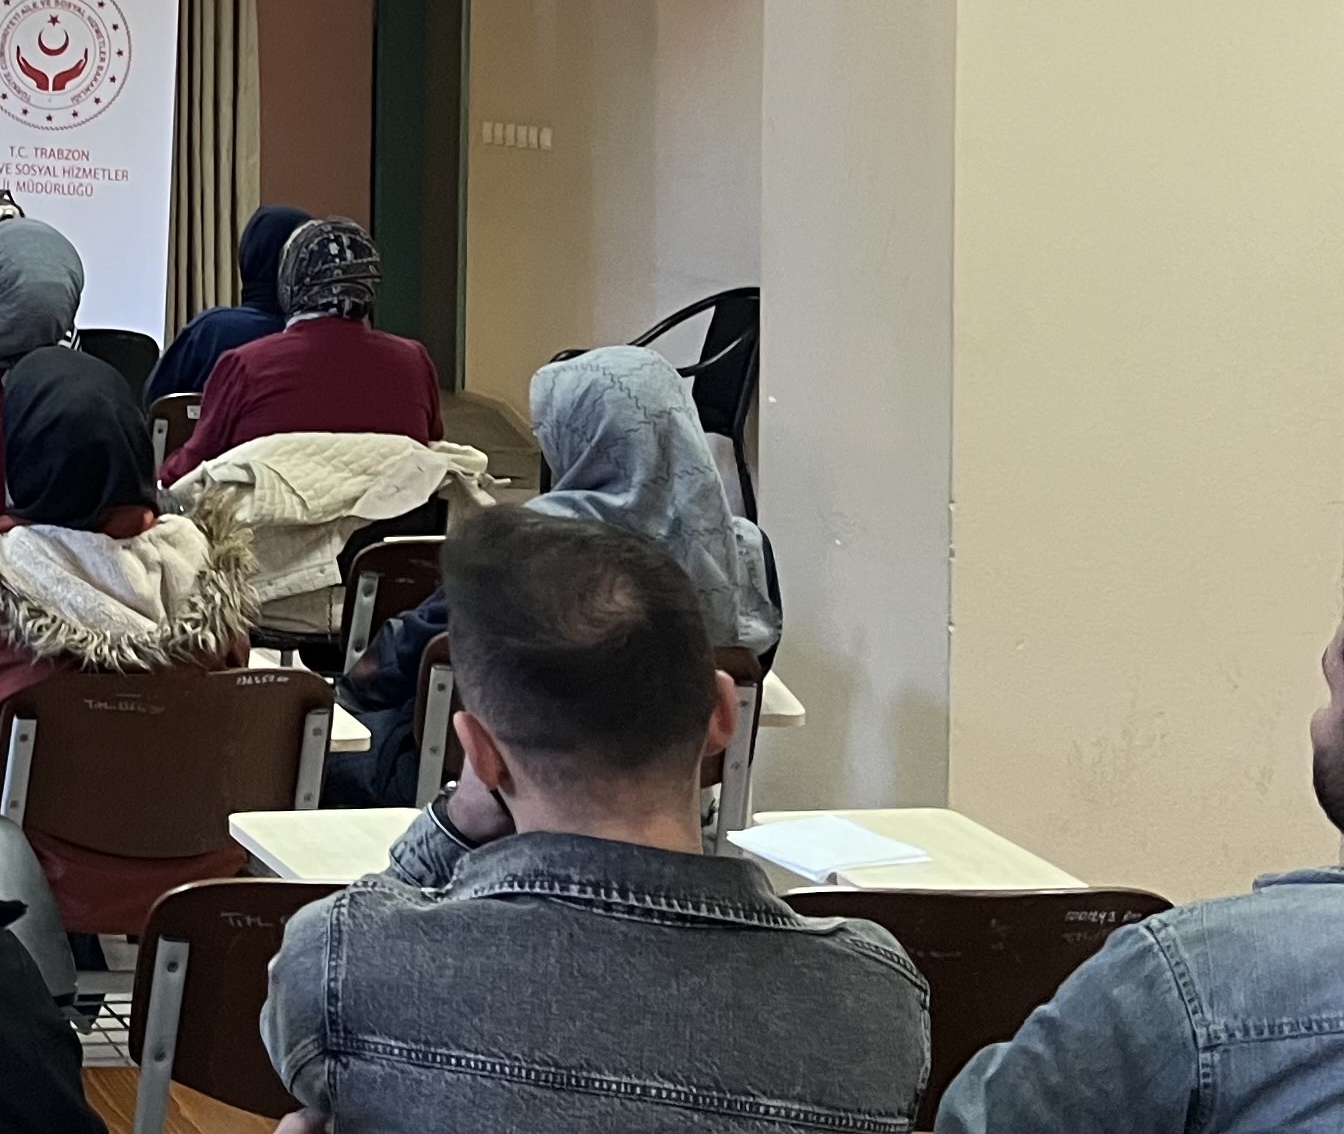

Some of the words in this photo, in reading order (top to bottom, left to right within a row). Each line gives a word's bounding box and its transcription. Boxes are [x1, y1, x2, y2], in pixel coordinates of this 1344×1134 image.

[33, 146, 90, 162] TRABZON
[14, 163, 59, 179] SOSYAL
[62, 164, 130, 182] HİZMETLER
[15, 180, 95, 198] MÜDÜRLÜĞÜ
